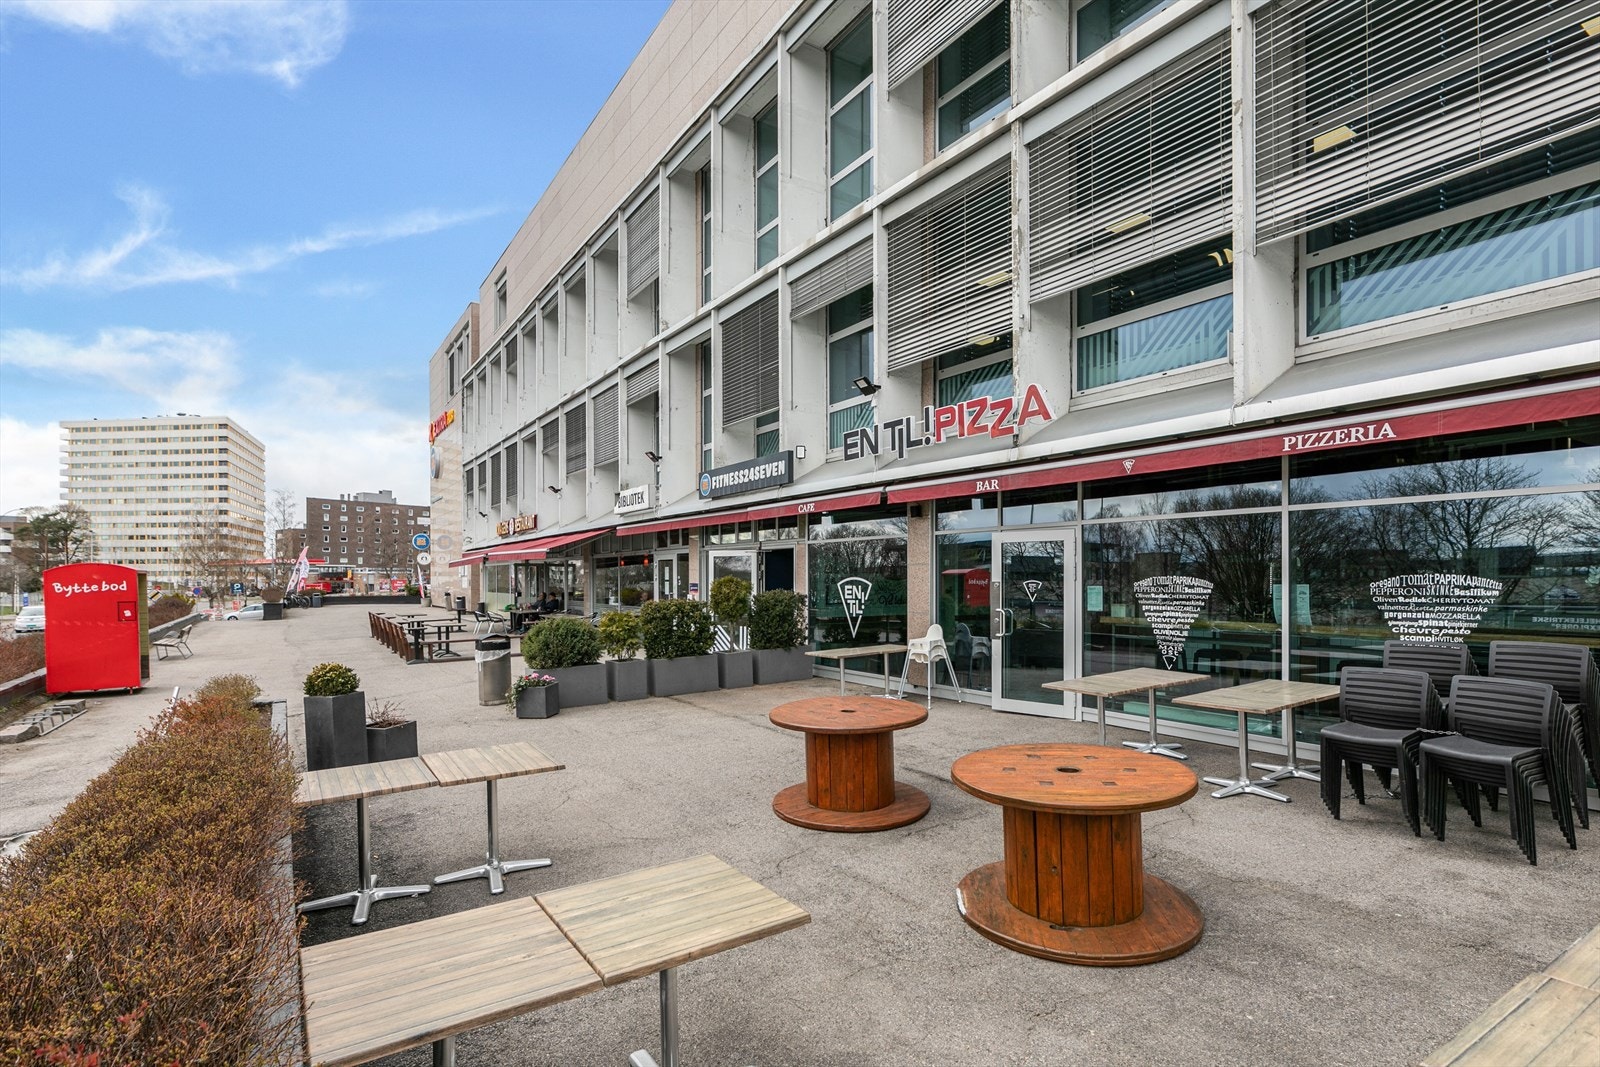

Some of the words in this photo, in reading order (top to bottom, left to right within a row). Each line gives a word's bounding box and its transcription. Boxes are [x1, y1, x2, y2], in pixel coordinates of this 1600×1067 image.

[842, 423, 881, 462] EN
[934, 382, 1056, 444] PIZZA
[1281, 422, 1397, 451] PIZZERIA
[711, 460, 786, 490] FITNESS24SEVEN
[975, 479, 1000, 492] BAR
[797, 502, 816, 513] CAFE
[1369, 575, 1401, 588] oregano
[1434, 573, 1472, 587] PAPRIKA
[844, 585, 862, 600] EN
[1369, 587, 1426, 596] PEPPERONI
[1426, 584, 1455, 596] SKINKE
[1454, 588, 1500, 597] Basilikum
[1427, 596, 1496, 604] CHERRYTOMAT
[1433, 604, 1489, 613] parmaskinke
[1384, 611, 1430, 619] gorgonzola
[1430, 612, 1481, 620] MOZZARELLA
[1418, 619, 1449, 628] spinat
[1391, 625, 1440, 635] chevre
[1439, 626, 1471, 637] pesto
[1399, 634, 1435, 643] scampi
